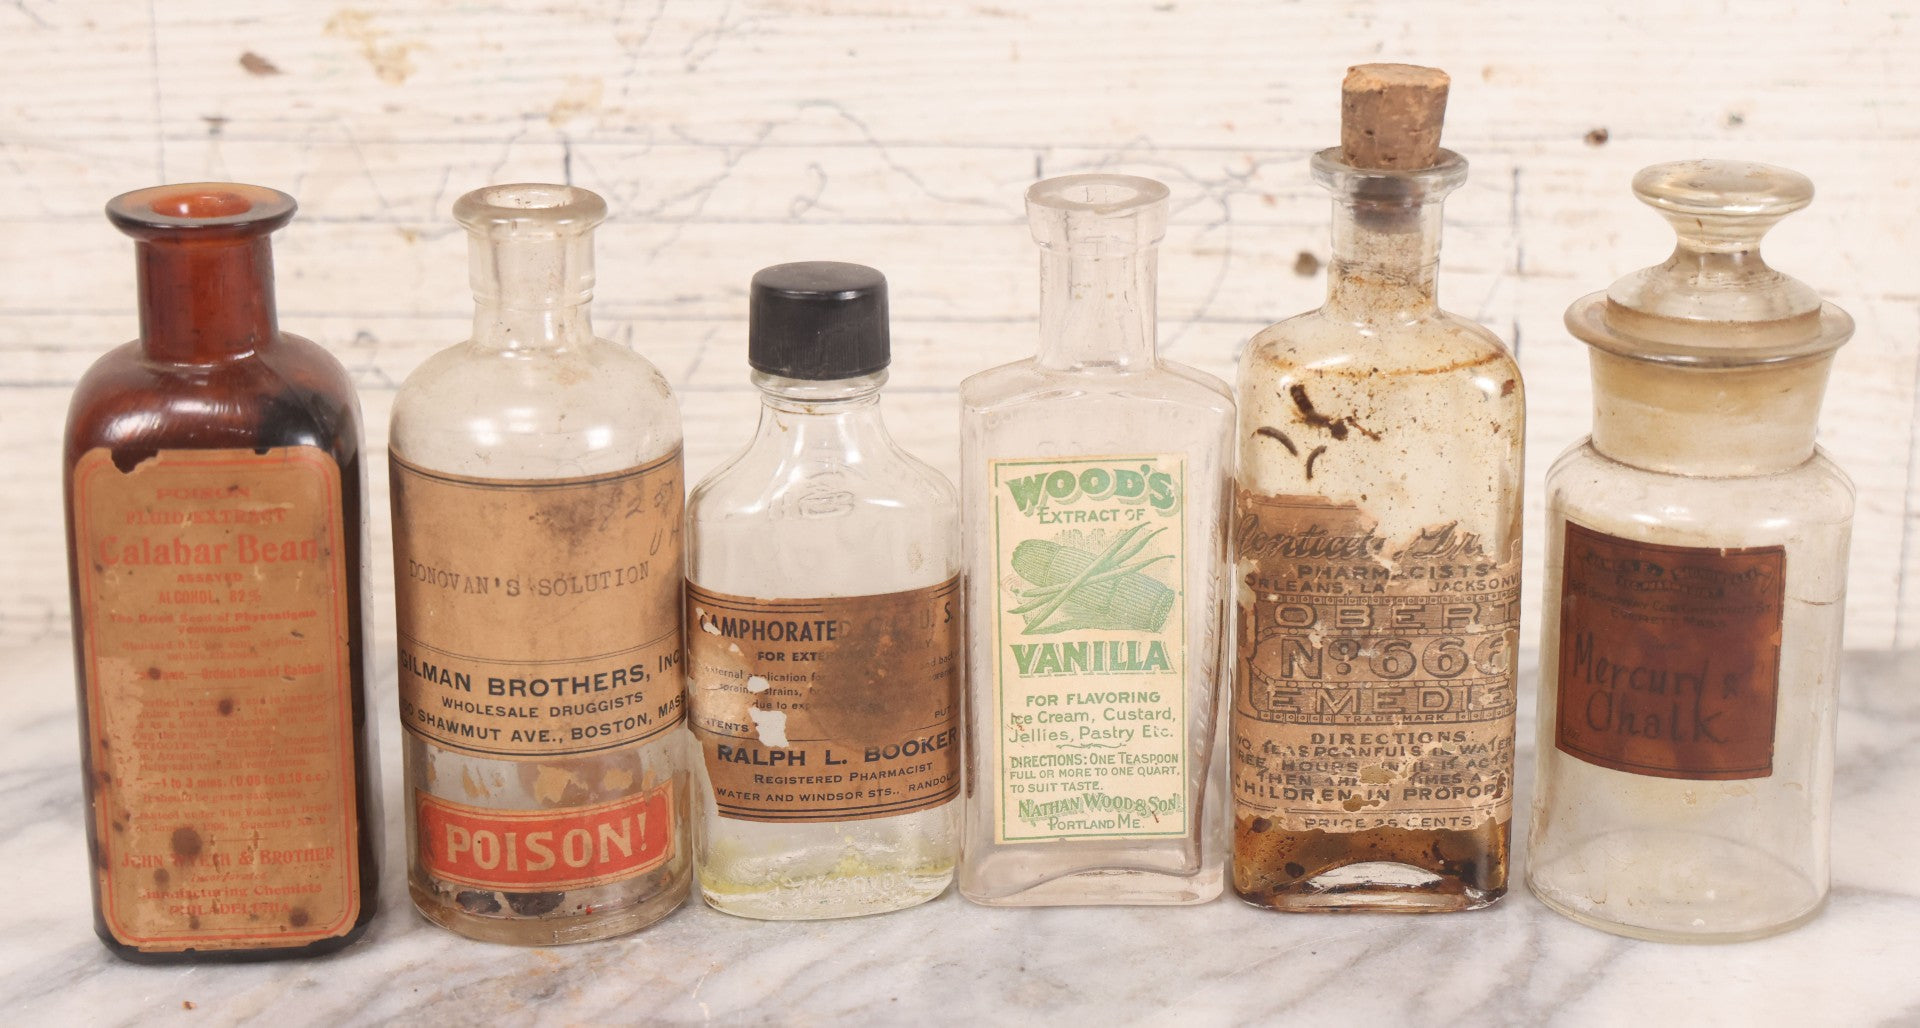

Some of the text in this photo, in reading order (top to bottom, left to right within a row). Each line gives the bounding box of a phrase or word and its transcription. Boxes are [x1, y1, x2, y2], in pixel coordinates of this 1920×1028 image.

[1004, 463, 1178, 515] WOOD'S
[1036, 506, 1147, 525] EXTRACT OF
[100, 533, 318, 566] Calabar Bean
[408, 559, 650, 597] DONOVAN'S SOLUTION
[757, 651, 785, 662] FOR
[1009, 640, 1174, 676] VANILLA
[401, 648, 472, 693] GILMAN
[487, 664, 651, 698] BROTHERS,
[441, 695, 539, 718] WHOLESALE
[549, 691, 644, 718] DRUGGISTS
[776, 701, 788, 710] to
[1025, 691, 1162, 707] FOR FLAVORING
[417, 708, 502, 741] SHAWMUT
[570, 711, 652, 741] BOSTON,
[1010, 707, 1177, 726] Ice Cream, Custard,
[1344, 712, 1448, 723] TRADE MARK
[1586, 689, 1729, 745] Chalk
[1008, 724, 1175, 746] Jellies, Pastry Etc.
[1310, 730, 1475, 745] DIRECTIONS:
[717, 726, 958, 767] RALPH L. BOOKER
[1459, 735, 1512, 755] WATER
[1010, 751, 1180, 769] DIRECTIONS: ONE TEASPOON
[1281, 760, 1359, 775] HOURS
[1010, 770, 1036, 780] FULL
[1039, 769, 1054, 779] OR
[1058, 768, 1092, 778] MORE
[1094, 767, 1108, 777] TO
[1111, 766, 1135, 776] ONE
[1470, 772, 1482, 782] A
[716, 788, 761, 801] WATER
[765, 793, 794, 803] AND
[799, 790, 864, 803] WINDSOR
[1010, 780, 1104, 794] TO SUIT TASTE.
[1235, 774, 1353, 801] CHILDREN
[1367, 788, 1390, 802] IN
[1018, 797, 1082, 820] NATHAN
[1082, 792, 1134, 813] WOOD
[444, 812, 648, 873] POISON!
[260, 847, 336, 866] BROTHER
[254, 883, 322, 897] Chemists
